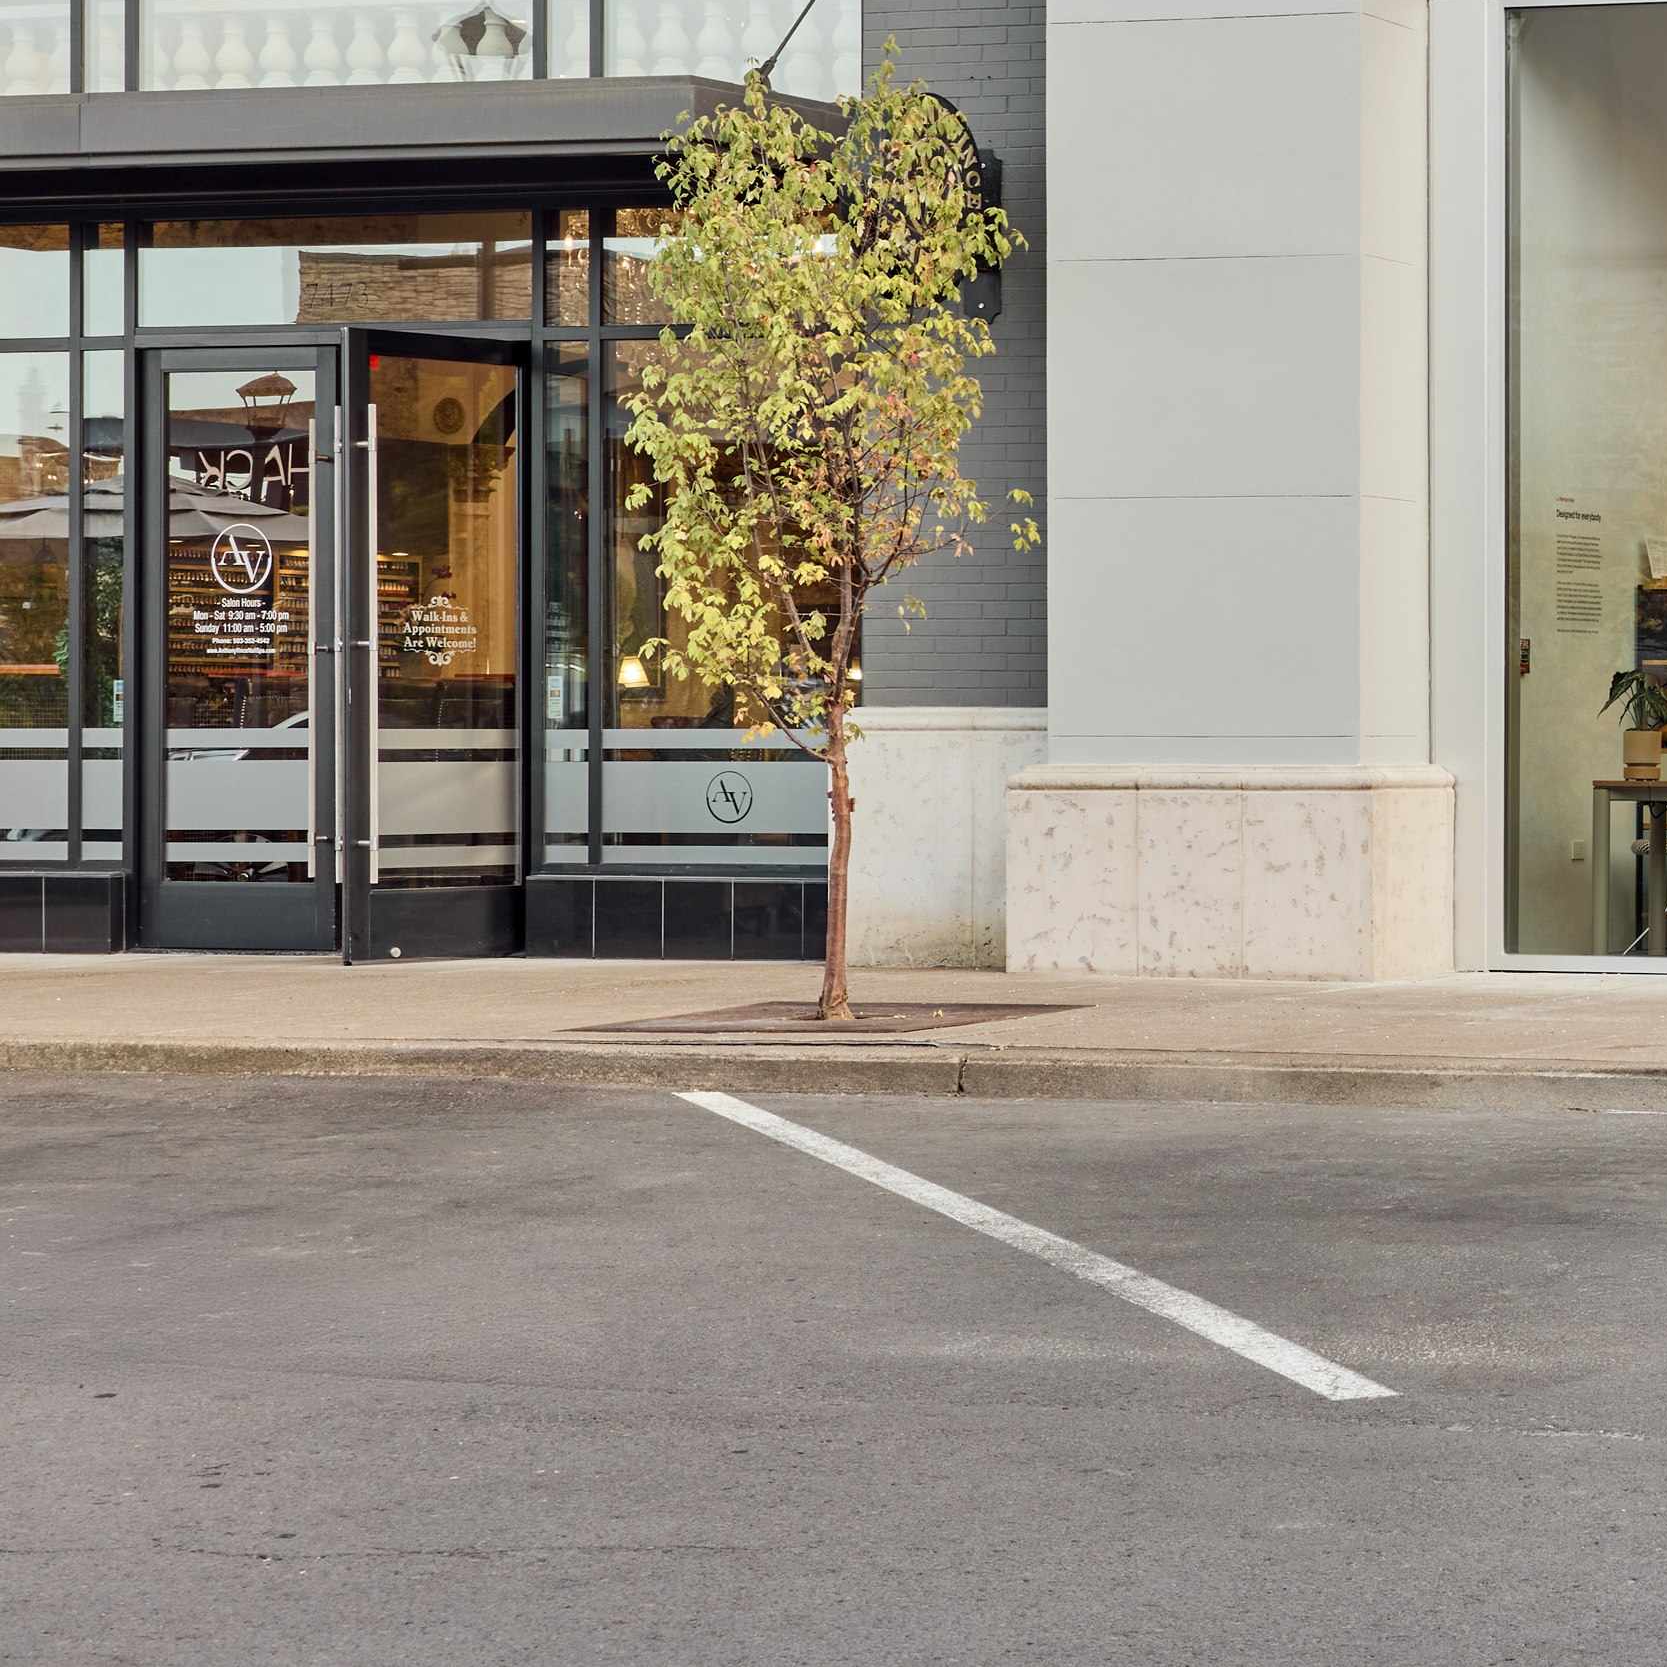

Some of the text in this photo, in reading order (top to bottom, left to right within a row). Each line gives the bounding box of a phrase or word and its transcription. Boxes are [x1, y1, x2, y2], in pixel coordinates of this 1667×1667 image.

[304, 281, 369, 309] 7473
[221, 597, 241, 608] Salon
[241, 597, 262, 608] Hours
[193, 610, 209, 620] Mon
[214, 610, 226, 620] Sat
[228, 610, 244, 620] 9:30
[244, 612, 256, 620] am
[261, 610, 277, 620] 7:00
[278, 612, 290, 622] pm
[411, 611, 469, 622] Walk-Ins &
[195, 623, 219, 634] Sunday
[222, 623, 242, 633] 11:00
[243, 625, 254, 633] am
[260, 623, 276, 633] 5:00
[276, 625, 288, 634] pm
[403, 622, 477, 636] Appointments
[403, 636, 477, 648] Are Welcome!
